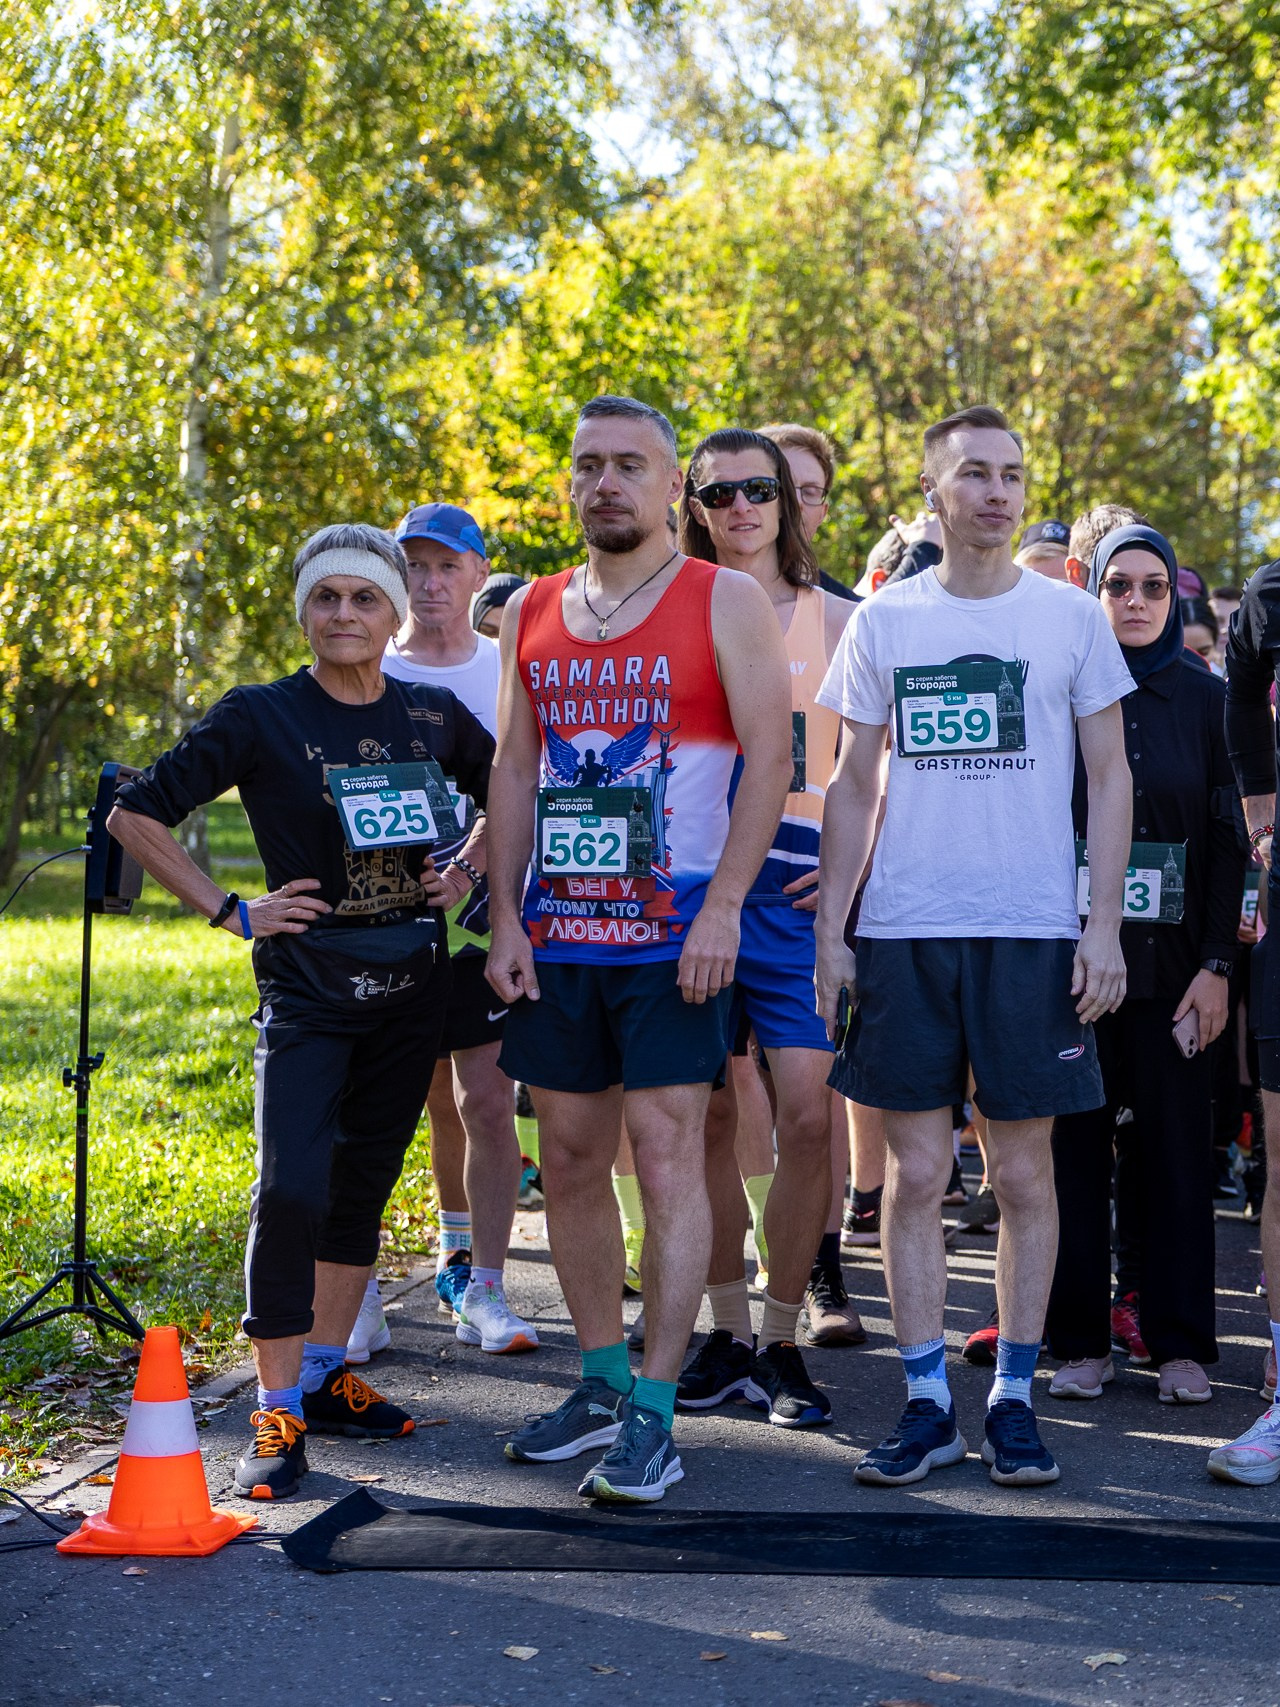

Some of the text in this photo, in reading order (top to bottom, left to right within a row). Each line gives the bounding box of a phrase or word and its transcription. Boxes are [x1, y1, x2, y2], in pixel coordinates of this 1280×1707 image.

[529, 655, 671, 690] SAMARA
[535, 686, 671, 700] NTERNATIONAL
[906, 678, 958, 690] 5 городов
[535, 698, 670, 726] MARATHON
[910, 708, 991, 746] 559
[915, 758, 1036, 771] GASTRONAUT
[341, 779, 390, 790] 5 городов
[556, 803, 593, 812] городов
[354, 804, 430, 839] 625
[549, 832, 621, 866] 562
[566, 877, 637, 899] БЕГУ,
[341, 903, 376, 912] KAZAN
[537, 898, 639, 918] ПОТОМУ ЧТО
